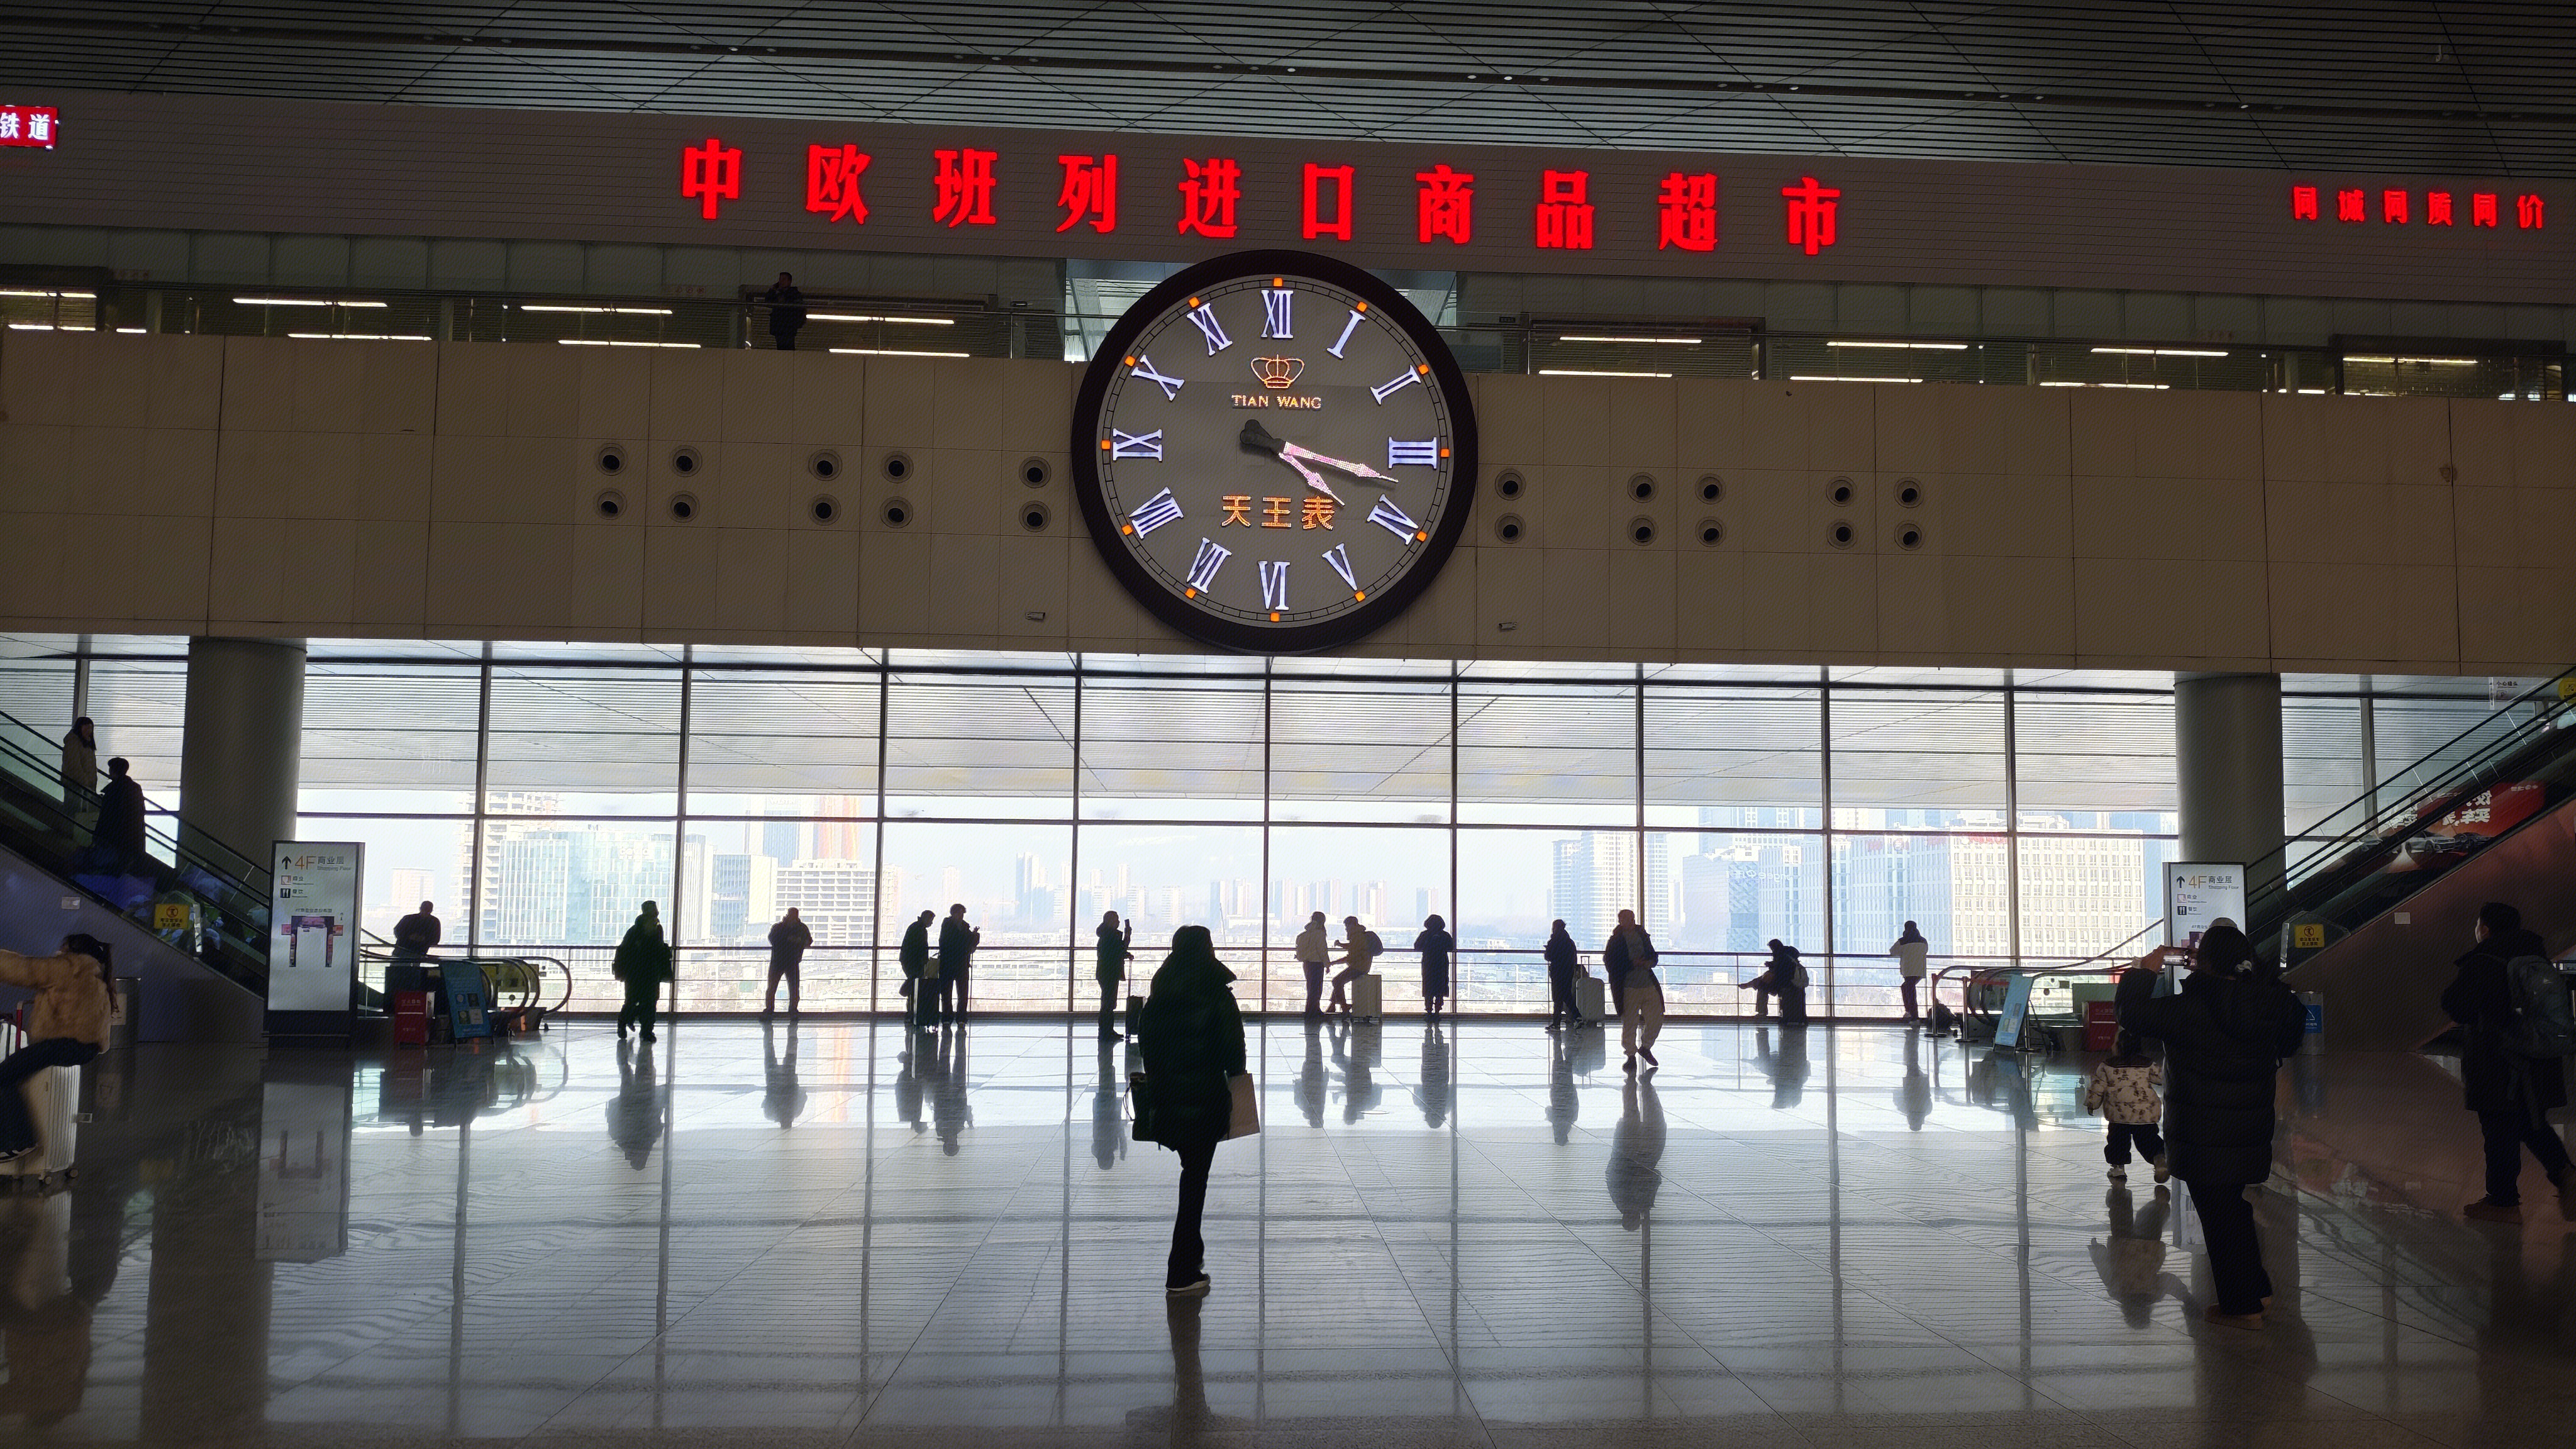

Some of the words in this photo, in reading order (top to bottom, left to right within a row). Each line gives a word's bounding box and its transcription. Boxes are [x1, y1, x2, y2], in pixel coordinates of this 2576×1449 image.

[0, 112, 50, 140] 铁道
[682, 138, 1841, 256] 中欧班列进口商品超市
[2292, 186, 2545, 230] 同城同质同价
[1231, 394, 1270, 408] TIAN
[1276, 396, 1321, 409] WANG
[1221, 495, 1335, 531] 天王表
[294, 856, 316, 870] 4F
[2189, 875, 2207, 889] 4F
[2208, 875, 2233, 884] 商业层
